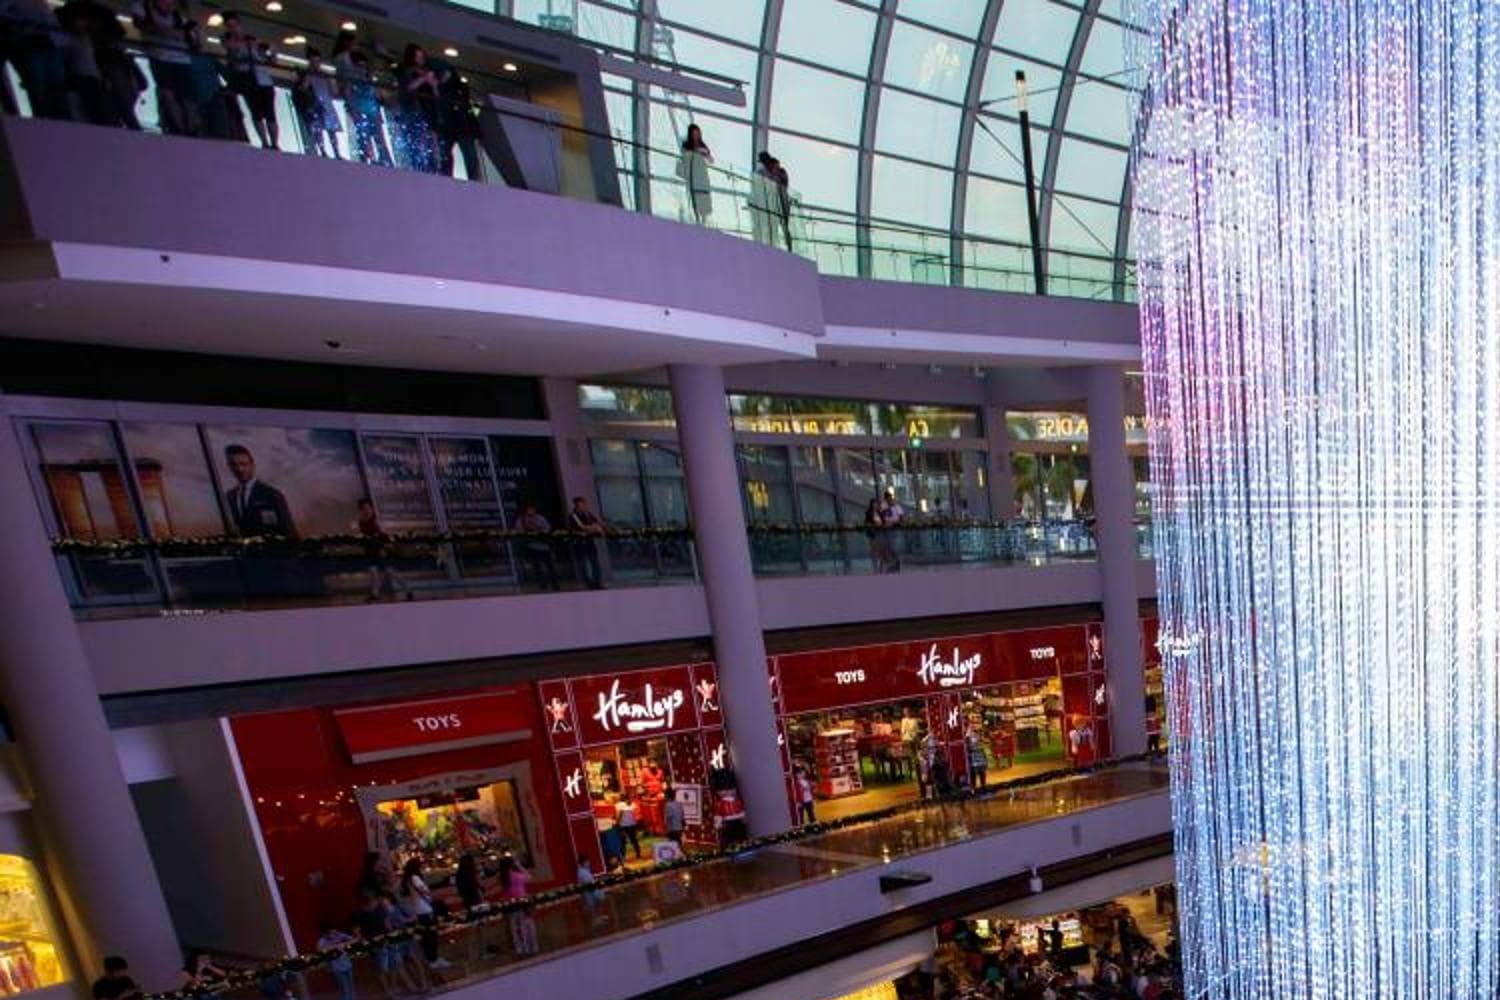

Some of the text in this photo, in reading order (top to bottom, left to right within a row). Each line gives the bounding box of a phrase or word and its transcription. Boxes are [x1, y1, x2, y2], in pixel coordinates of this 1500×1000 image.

[1029, 646, 1056, 660] TOYS
[917, 642, 982, 686] Hamleys
[834, 668, 865, 686] TOYS
[593, 679, 685, 732] Hamleys
[412, 713, 463, 732] TOYS
